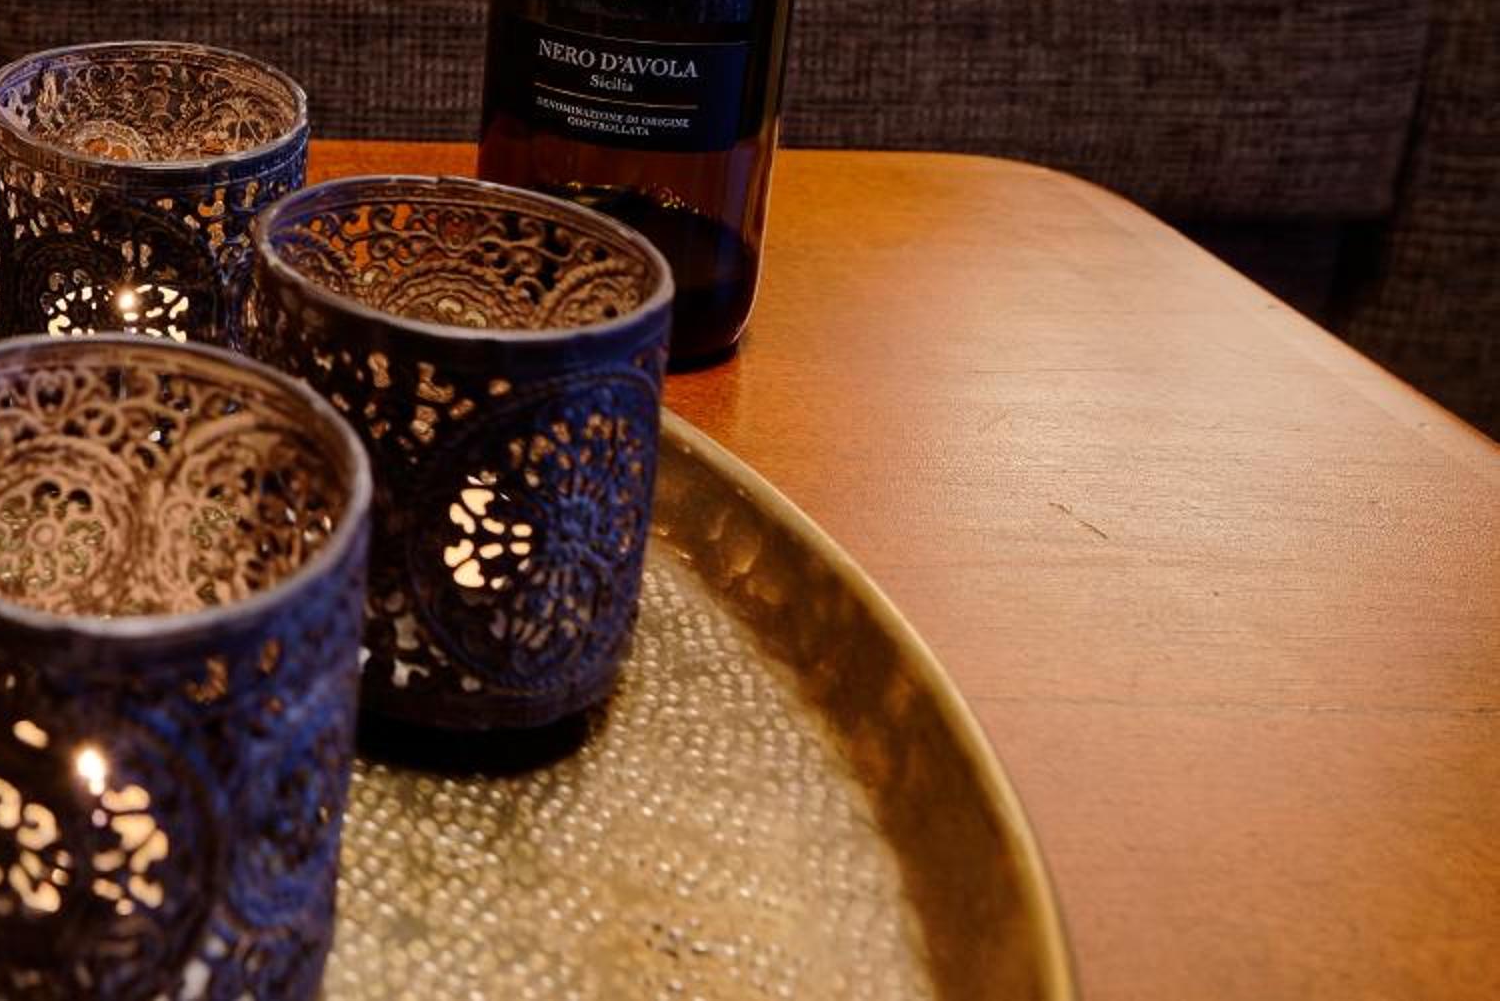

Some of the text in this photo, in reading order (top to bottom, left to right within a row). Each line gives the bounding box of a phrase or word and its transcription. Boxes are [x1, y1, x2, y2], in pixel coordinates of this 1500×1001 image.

[538, 38, 699, 78] NERO D'AVOLA
[589, 74, 634, 92] Sicilia
[535, 95, 690, 129] DENOMINAZIONE DI ORIGINE
[567, 116, 650, 136] CONTROLLATA
